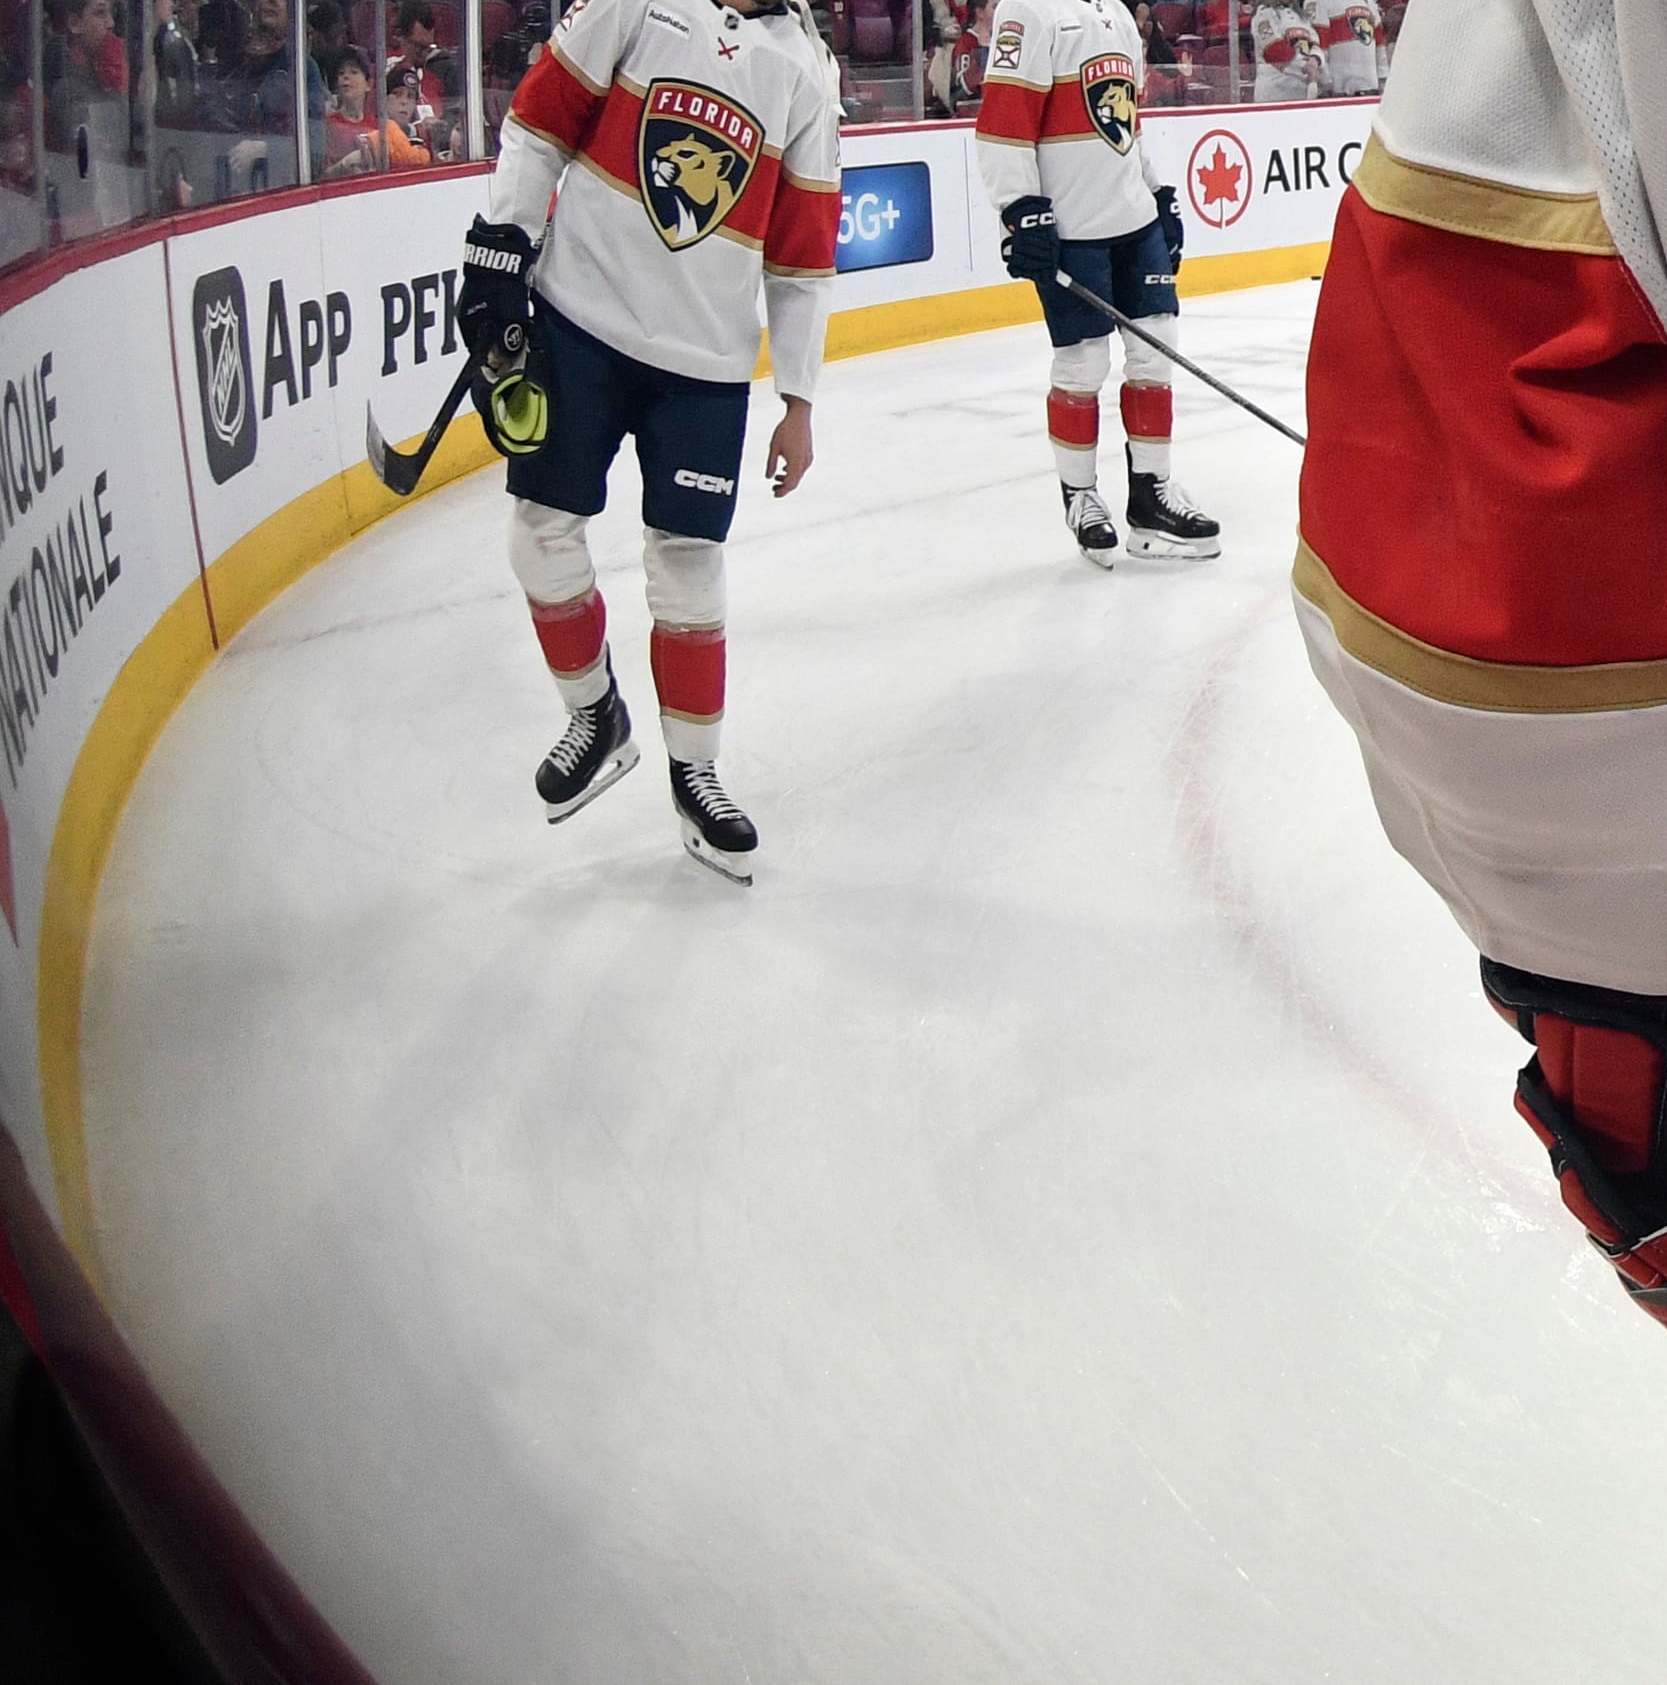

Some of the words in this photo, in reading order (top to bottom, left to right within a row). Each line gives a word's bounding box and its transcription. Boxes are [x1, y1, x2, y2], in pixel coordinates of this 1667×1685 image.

[649, 8, 691, 35] AutoNation
[657, 90, 756, 152] FLORIDA
[1263, 144, 1330, 195] AIR
[837, 192, 901, 245] 5G+
[674, 469, 735, 495] CCM
